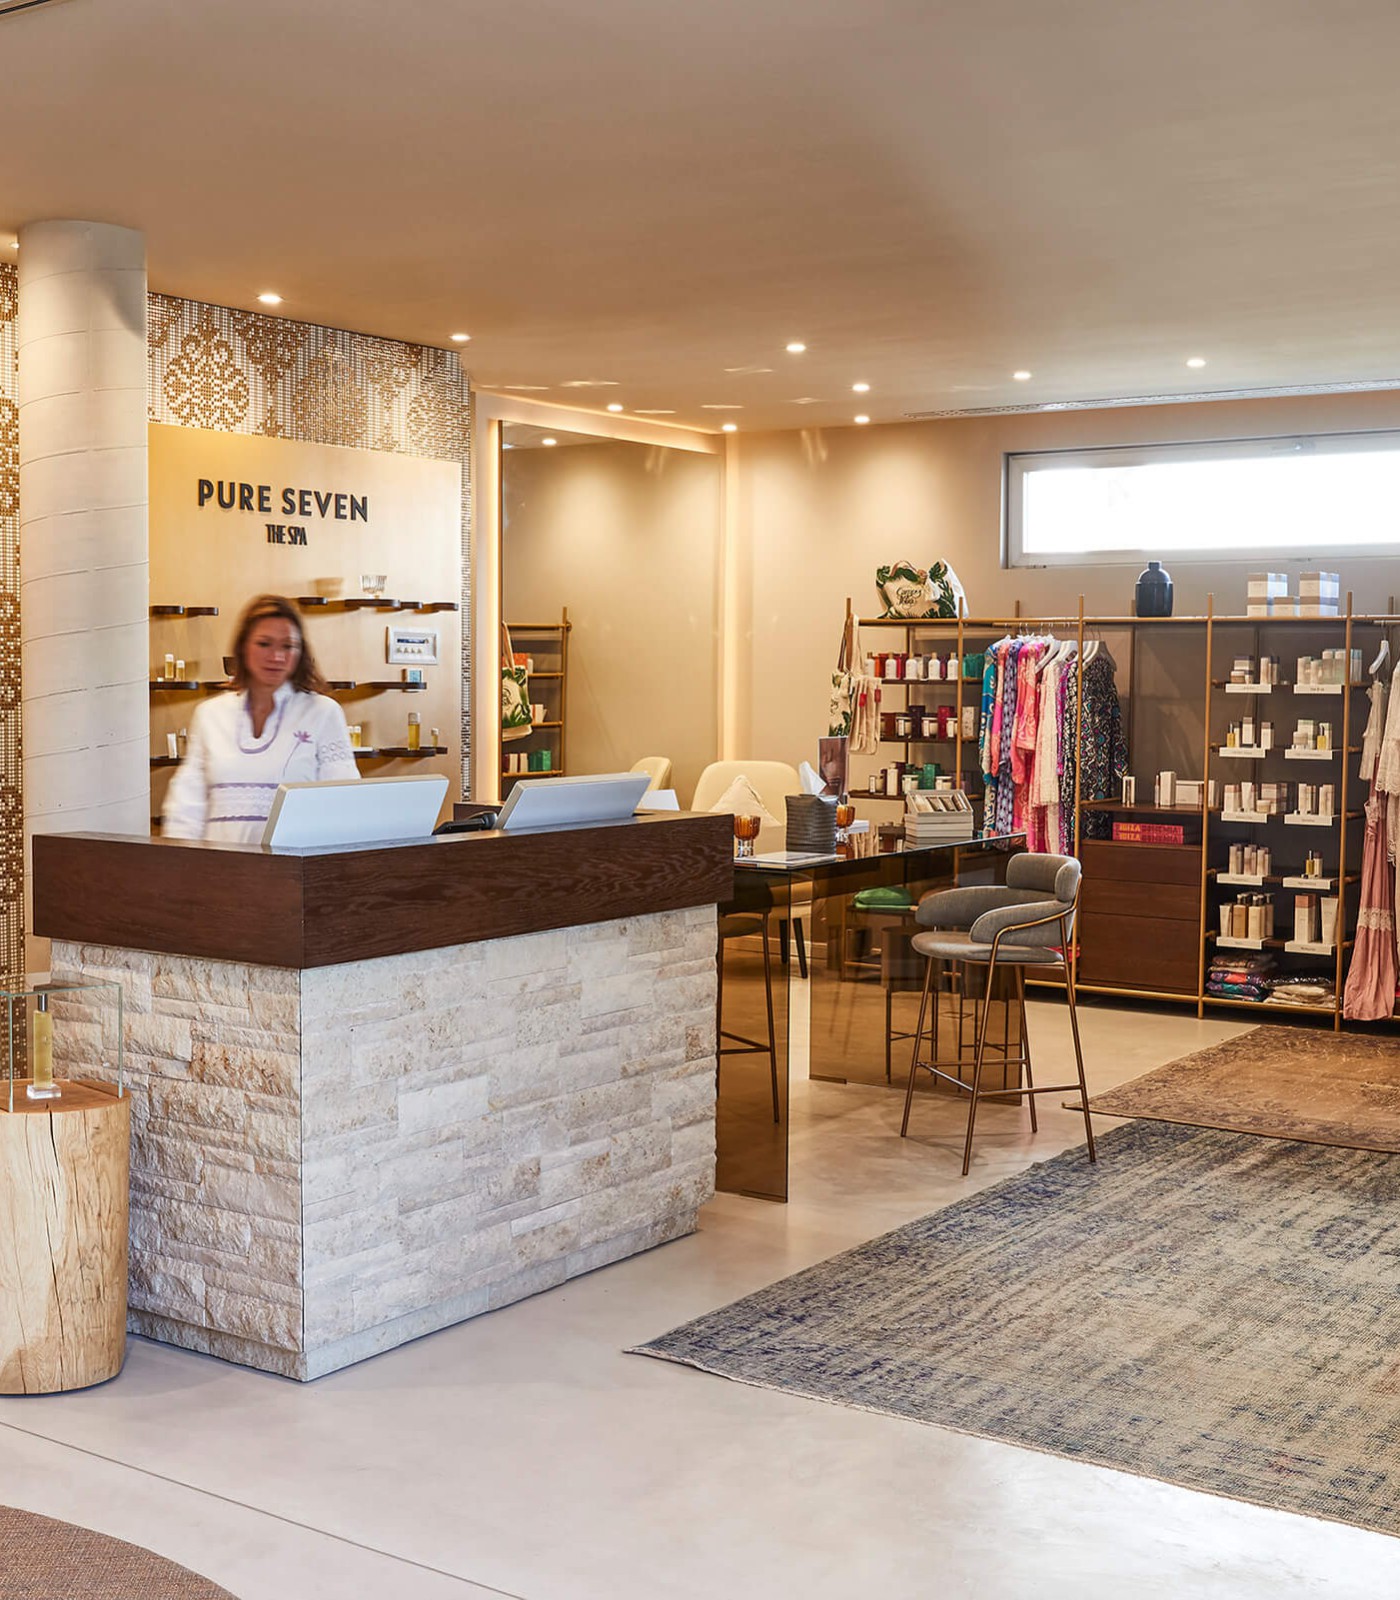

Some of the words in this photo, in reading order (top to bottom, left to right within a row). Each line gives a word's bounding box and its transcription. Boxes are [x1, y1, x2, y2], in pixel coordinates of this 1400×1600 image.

[198, 479, 272, 513] PURE
[282, 488, 368, 523] SEVEN
[265, 524, 286, 544] THE
[287, 526, 308, 546] SPA
